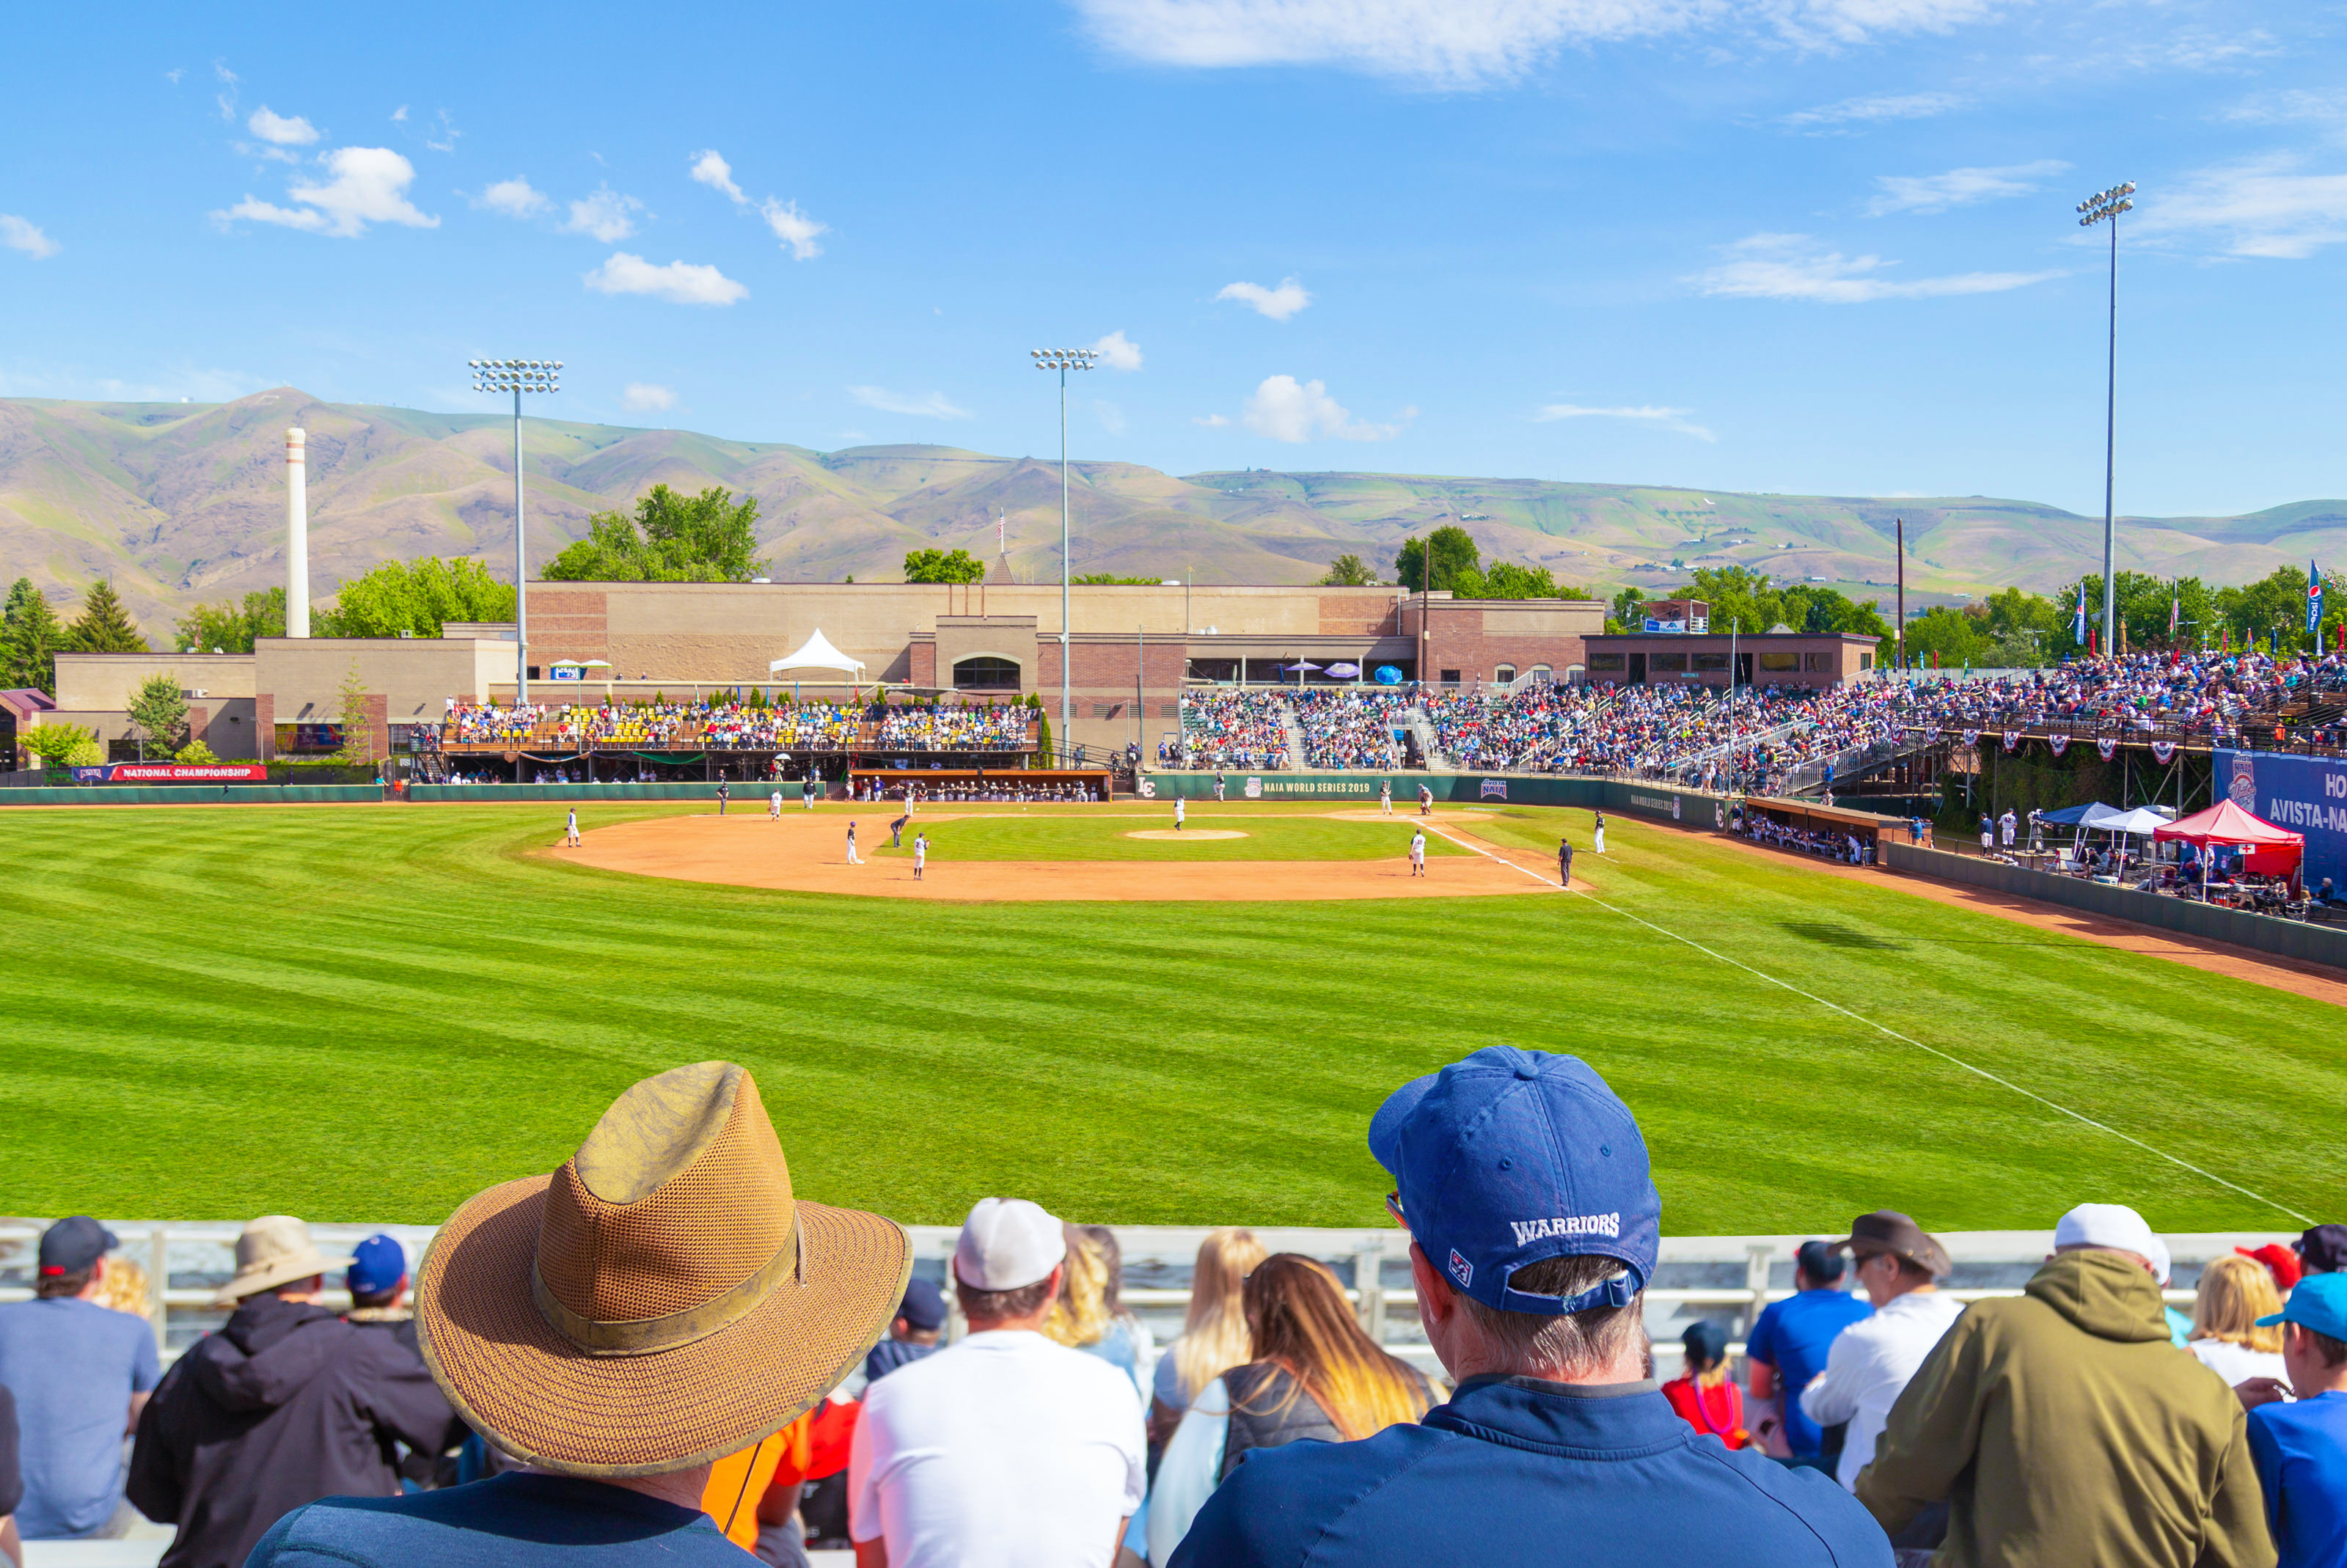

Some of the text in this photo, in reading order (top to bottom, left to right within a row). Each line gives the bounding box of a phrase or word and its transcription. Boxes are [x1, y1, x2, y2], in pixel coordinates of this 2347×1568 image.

[123, 768, 251, 777] NATIONAL CHAMPIONSHIP
[1264, 783, 1284, 792] NAIA
[1286, 783, 1315, 792] WORLD
[1317, 783, 1347, 792] SERIES
[1348, 783, 1370, 792] 2019
[1483, 785, 1505, 796] NAIA
[1510, 1212, 1620, 1248] WARRIORS
